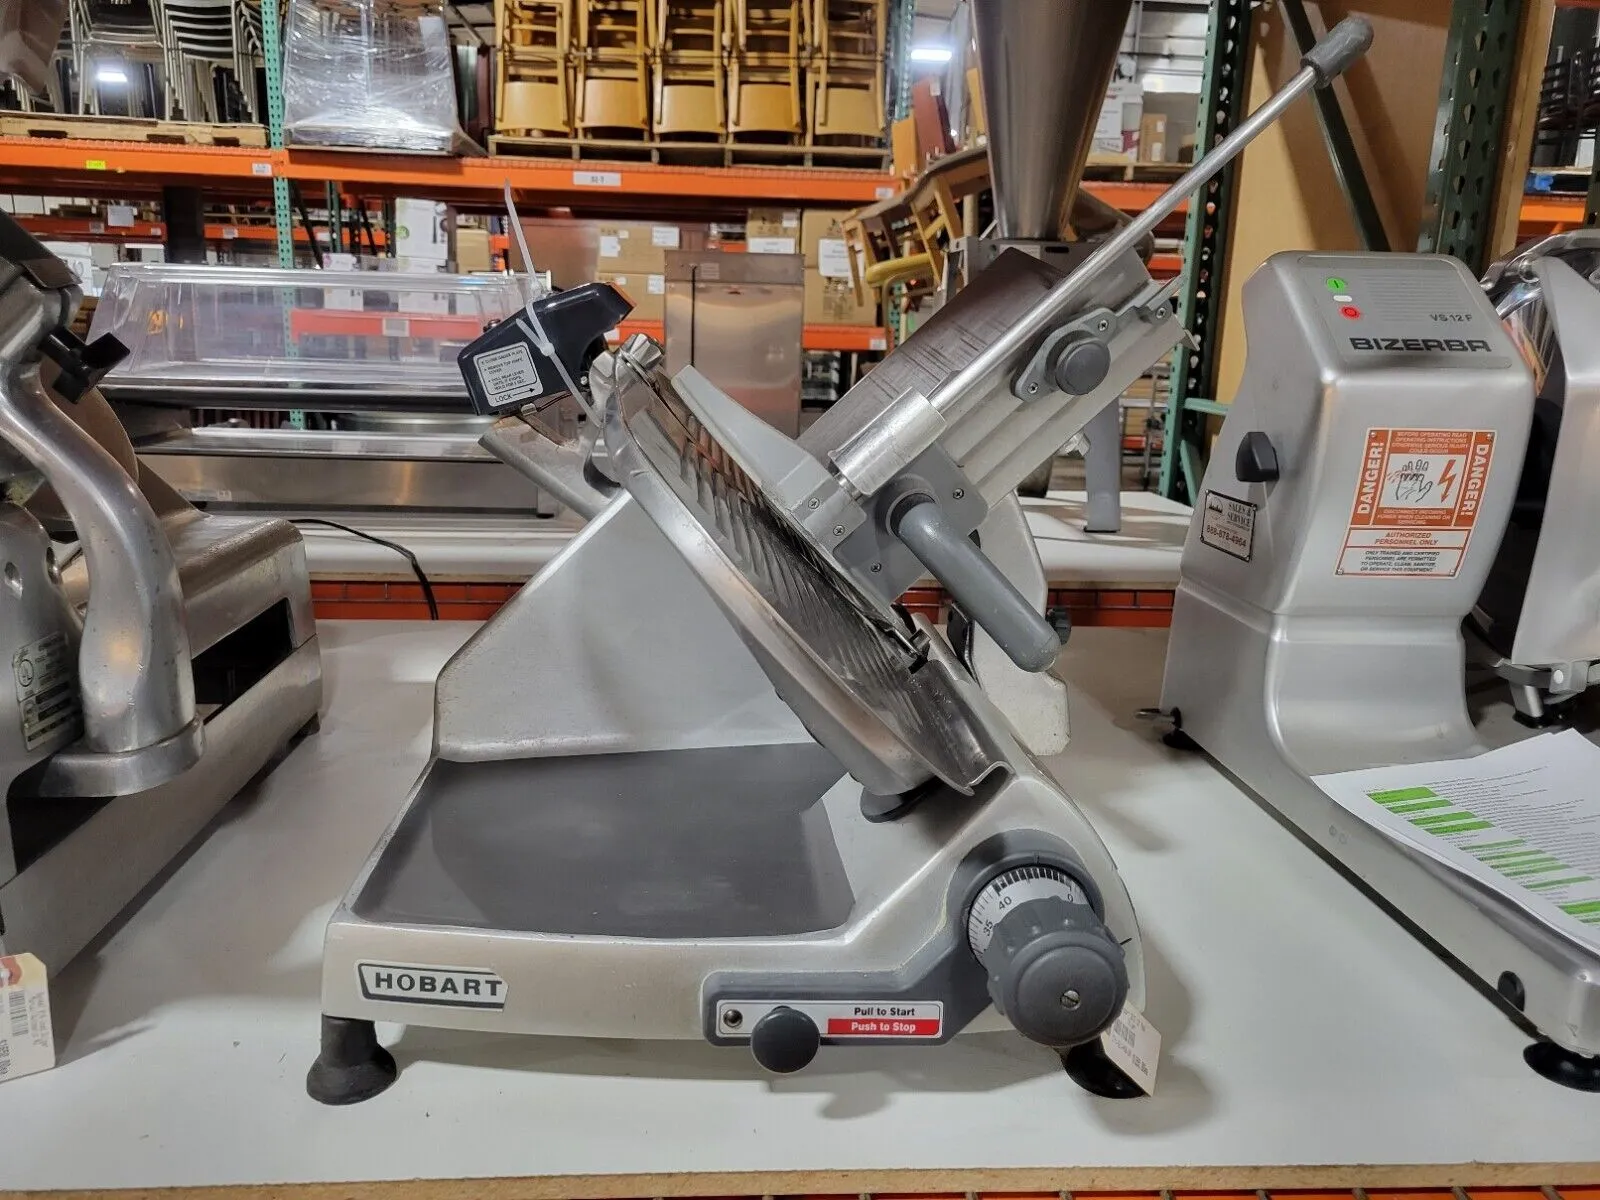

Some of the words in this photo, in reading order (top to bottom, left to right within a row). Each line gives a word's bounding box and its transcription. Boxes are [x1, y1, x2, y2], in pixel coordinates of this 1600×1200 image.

[1429, 313, 1448, 322] VS
[1450, 314, 1464, 322] 12
[1465, 314, 1473, 322] F
[1349, 337, 1492, 352] BIZERBA
[495, 394, 512, 403] LOCK
[1356, 442, 1384, 514] DANGER!
[1460, 443, 1489, 516] DANGER!
[1227, 511, 1251, 527] SERVICE
[998, 895, 1012, 910] 40
[983, 919, 994, 937] 35
[375, 972, 503, 996] HOBART
[854, 1007, 874, 1016] Pull
[876, 1007, 887, 1016] to
[889, 1007, 915, 1016] Start
[851, 1021, 877, 1031] Push
[880, 1022, 890, 1031] to
[892, 1021, 916, 1034] Stop
